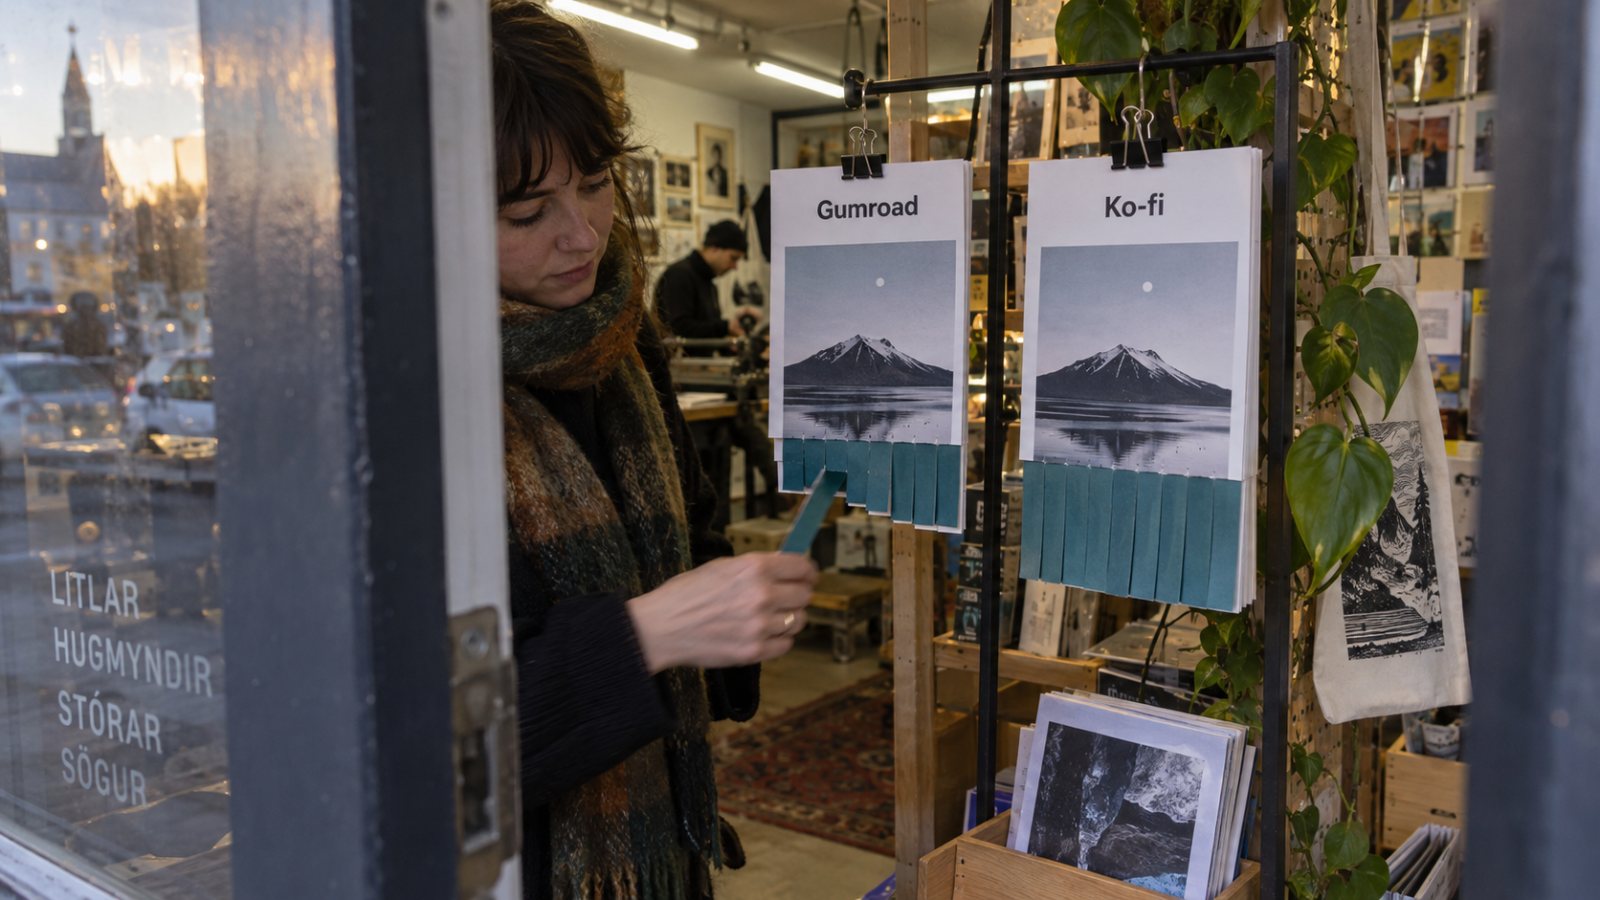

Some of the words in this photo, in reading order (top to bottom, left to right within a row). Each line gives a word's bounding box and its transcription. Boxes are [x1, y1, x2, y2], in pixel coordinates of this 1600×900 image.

[817, 194, 918, 220] Gumroad
[1105, 192, 1165, 218] Ko-fi
[51, 569, 140, 620] LITLAR
[54, 626, 213, 699] HUGMYNDIR
[58, 689, 163, 755] STÓRAR
[61, 743, 147, 807] SÖGUR
